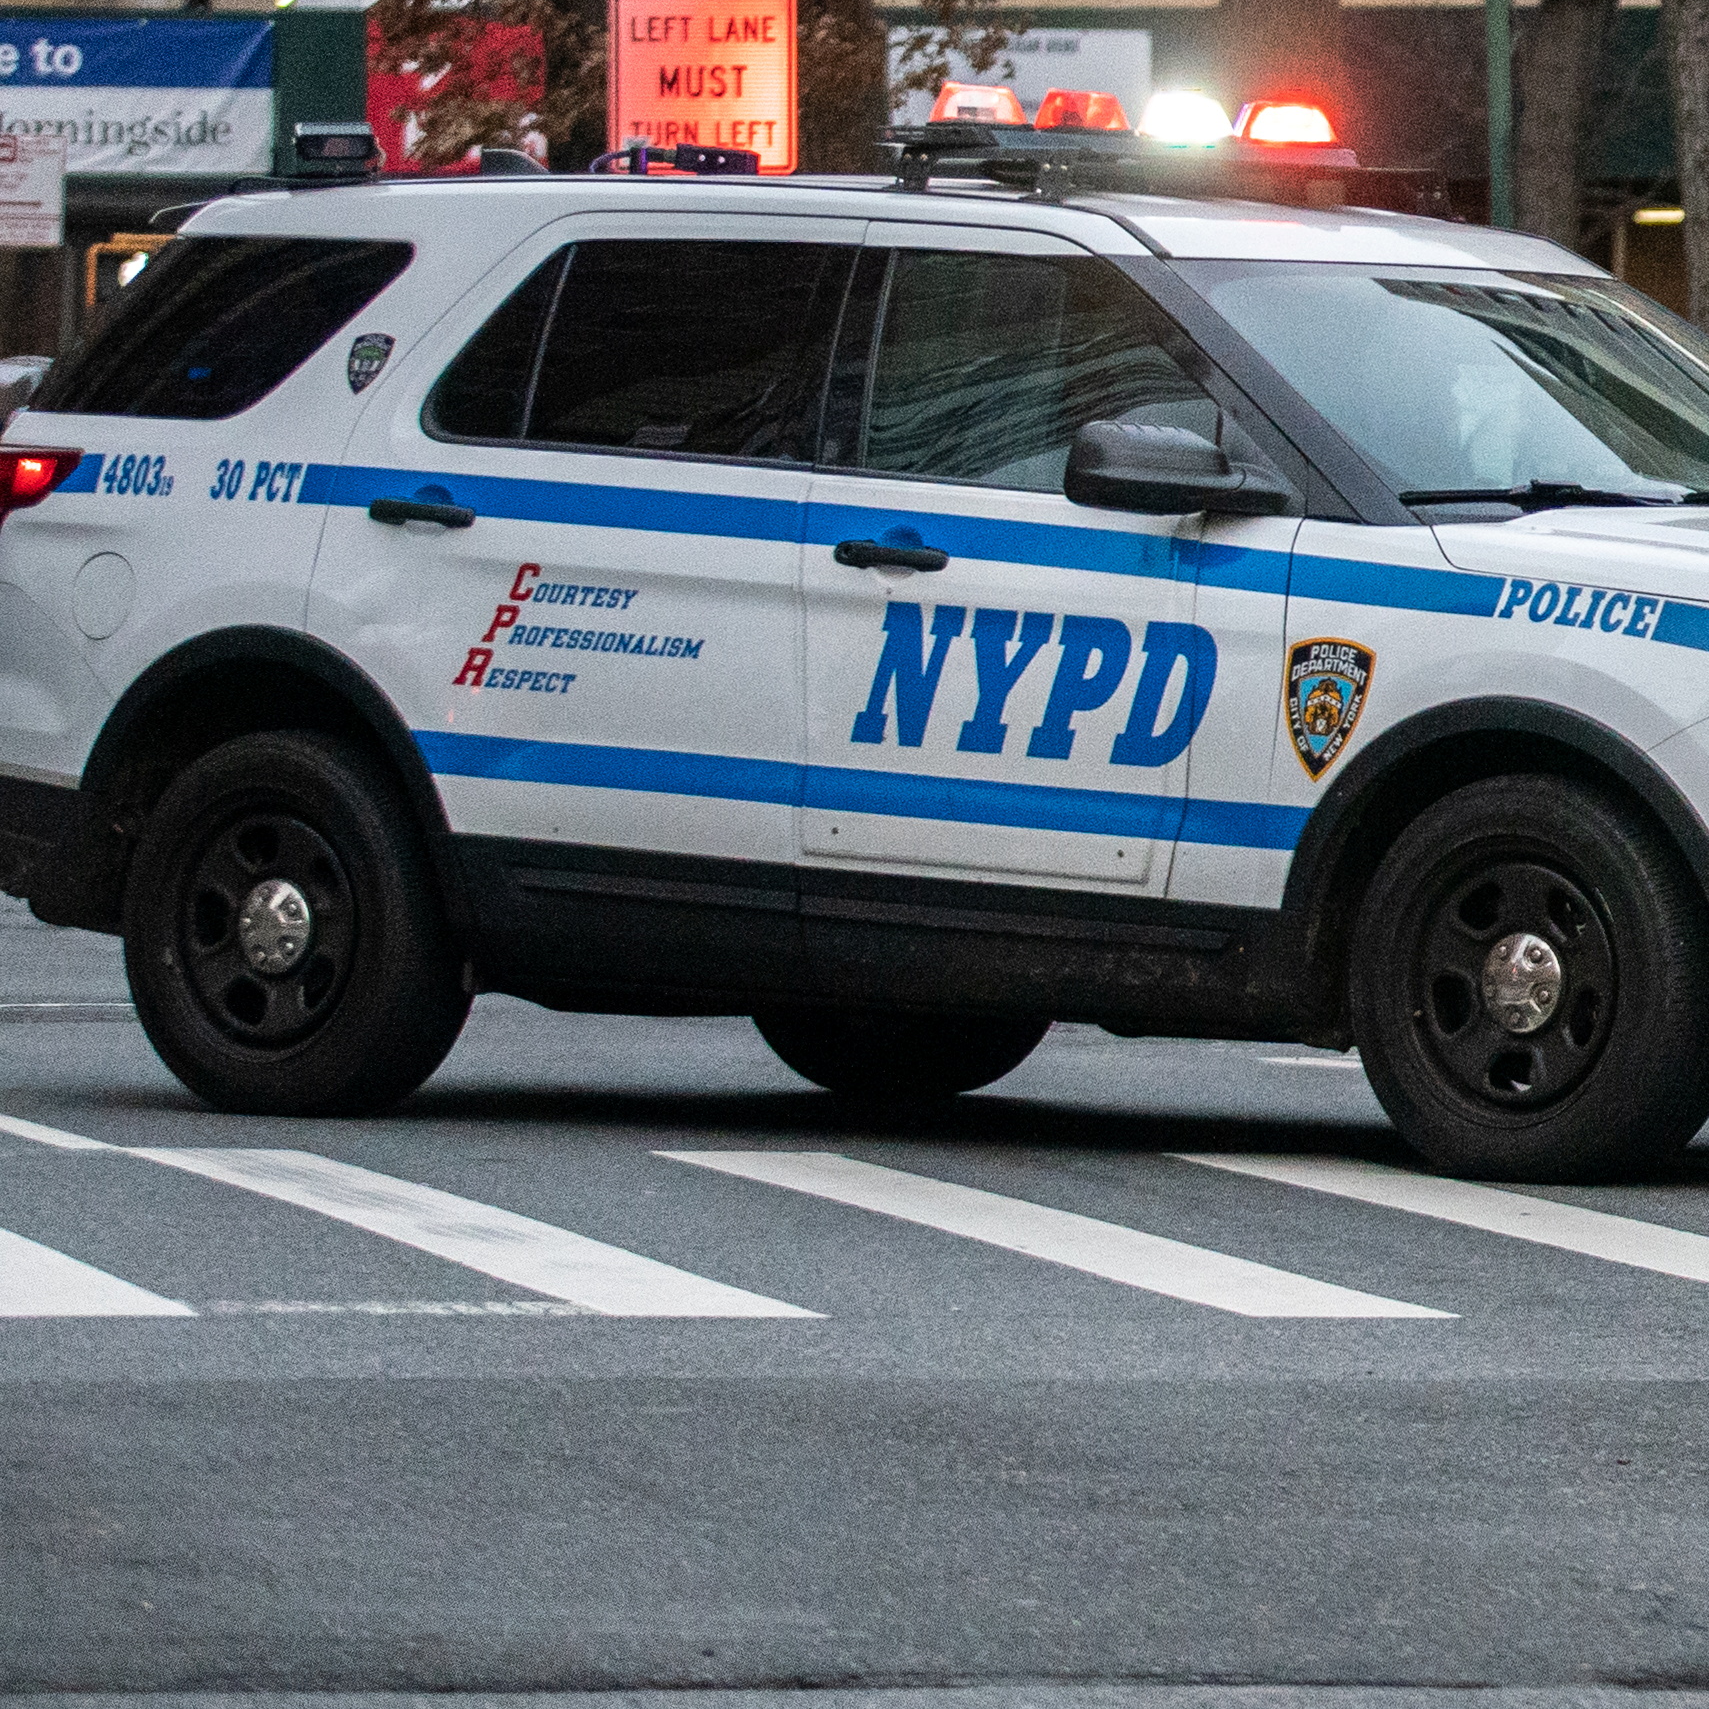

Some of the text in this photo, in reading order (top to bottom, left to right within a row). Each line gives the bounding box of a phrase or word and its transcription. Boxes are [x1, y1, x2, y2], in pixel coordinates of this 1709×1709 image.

[630, 15, 775, 43] LEFT LANE
[32, 39, 83, 76] to
[659, 66, 747, 98] MUST
[0, 109, 232, 156] orningside
[630, 120, 775, 146] TURN LEFT
[210, 458, 303, 502] 30 PCT
[510, 562, 639, 611] COURTESY
[1499, 578, 1662, 637] POLICE
[482, 604, 704, 660] PROFESSIONALISM
[1310, 644, 1358, 663] POLICE
[453, 647, 576, 695] RESPECT
[851, 601, 1218, 767] NYPD
[1291, 658, 1367, 686] DEPARTMENT
[1289, 697, 1309, 752] CITY OF
[1323, 694, 1362, 761] NEW YORK
